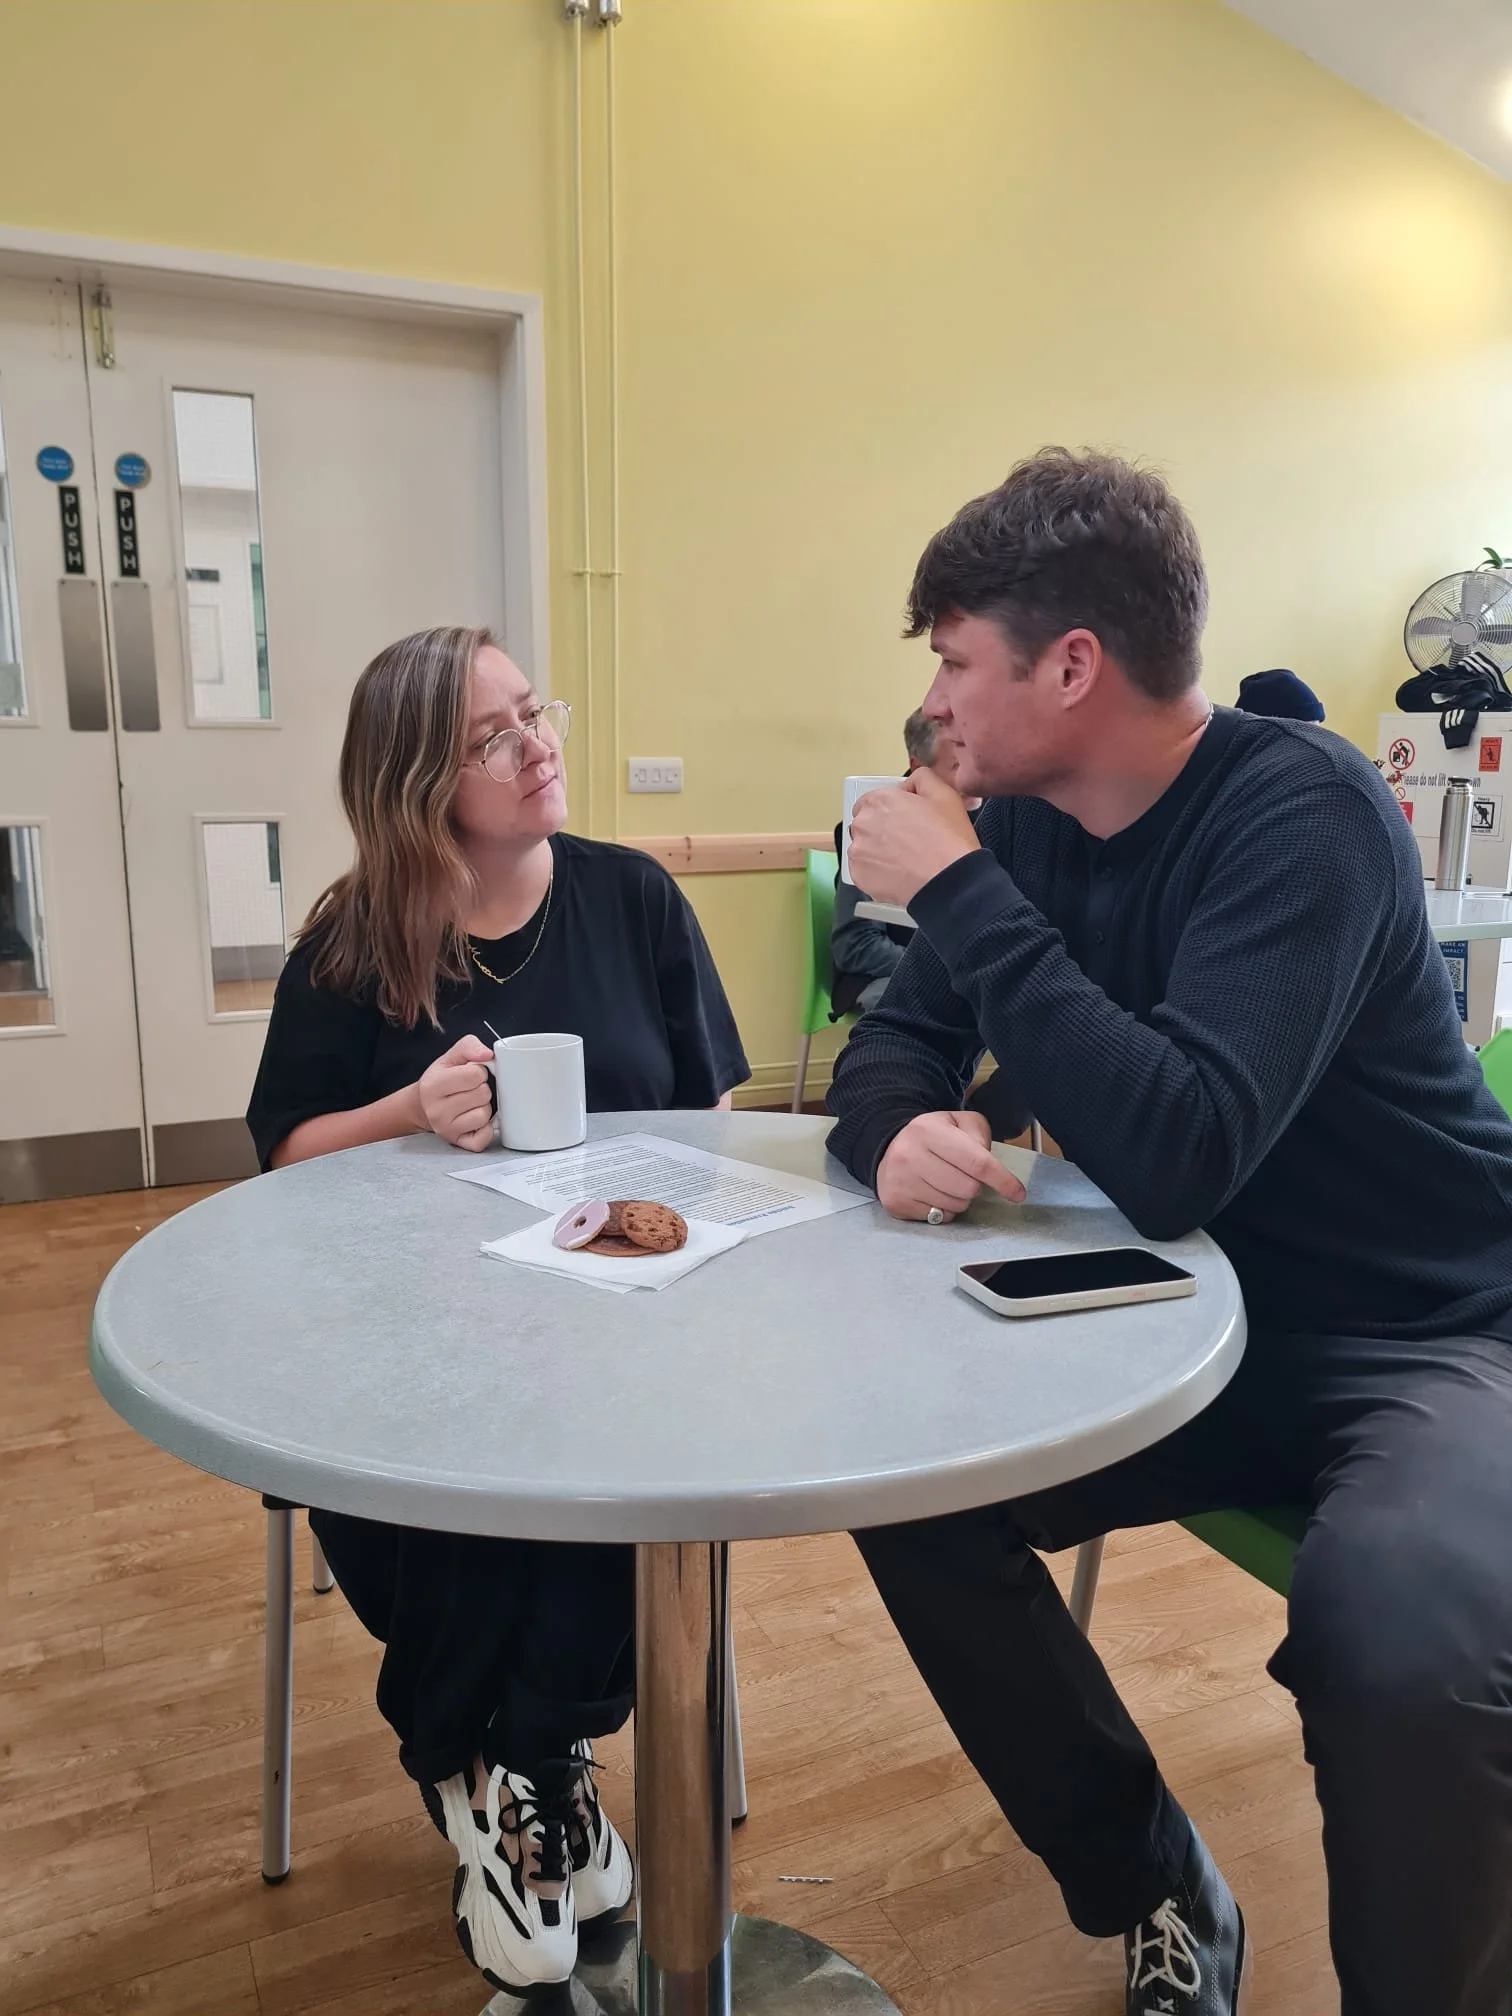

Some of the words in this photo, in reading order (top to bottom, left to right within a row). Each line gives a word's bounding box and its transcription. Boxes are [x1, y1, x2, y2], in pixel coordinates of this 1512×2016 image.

[64, 492, 82, 567] PUSH
[120, 496, 137, 569] PUSH
[1420, 772, 1427, 786] do
[1428, 773, 1437, 786] not
[1438, 772, 1447, 787] lift
